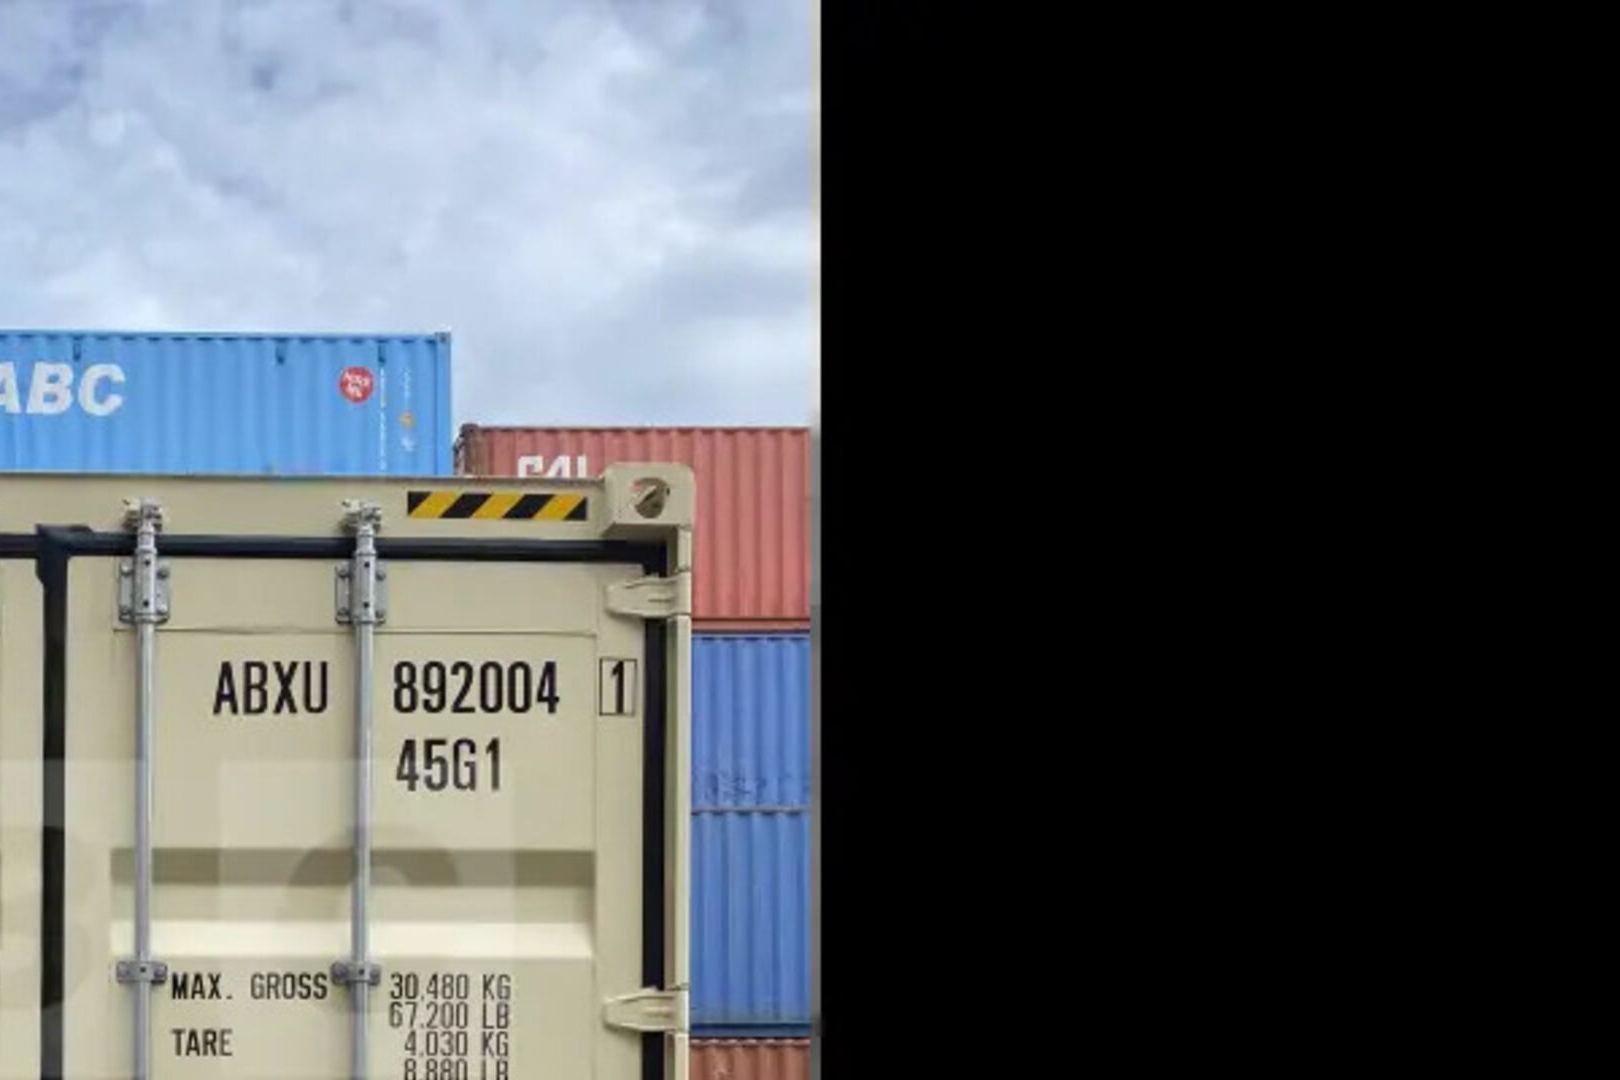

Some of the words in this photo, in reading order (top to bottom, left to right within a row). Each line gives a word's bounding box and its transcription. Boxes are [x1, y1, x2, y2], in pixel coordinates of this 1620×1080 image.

[213, 660, 329, 715] ABXU
[393, 660, 560, 714] 892004
[610, 661, 626, 713] 1
[396, 737, 501, 792] 45G1
[171, 973, 234, 1001] MAX.
[250, 972, 329, 1000] GROSS
[390, 972, 470, 1000] 30.480
[482, 973, 512, 1001] KG
[389, 1001, 469, 1030] 67.200
[482, 1001, 510, 1030] LB
[172, 1028, 233, 1057] TARE
[404, 1030, 468, 1057] 4.030
[481, 1031, 510, 1058] KG
